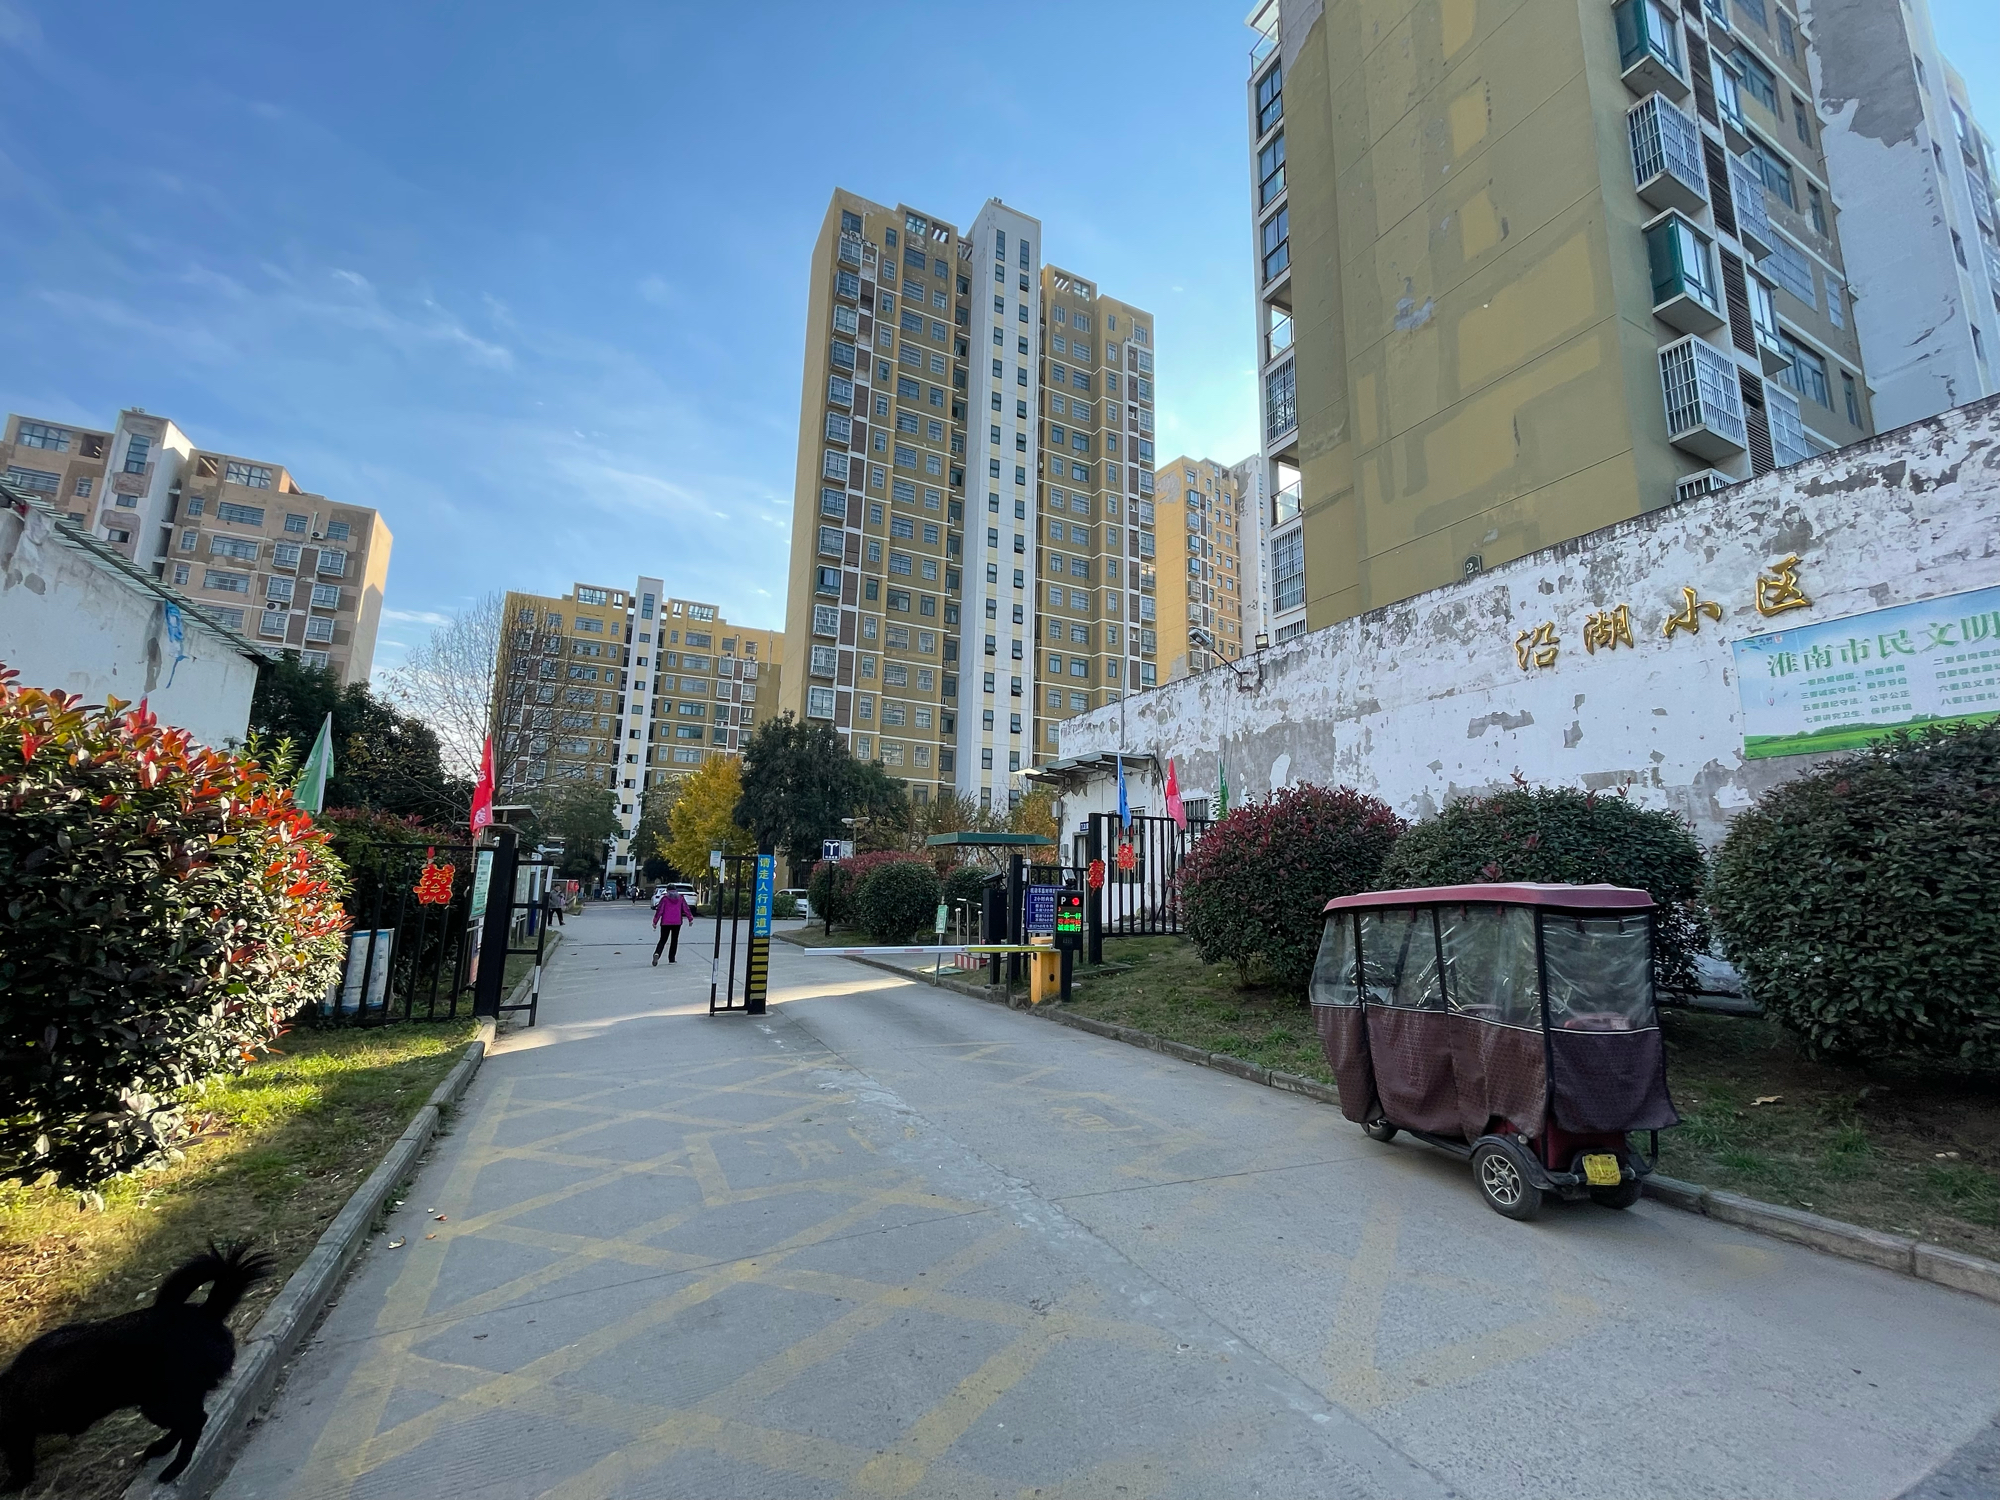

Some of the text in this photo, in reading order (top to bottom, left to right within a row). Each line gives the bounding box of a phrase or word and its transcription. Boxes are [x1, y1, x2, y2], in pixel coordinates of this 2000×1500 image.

[1514, 556, 1812, 671] 沿湖小区
[1767, 610, 2000, 677] 淮南市民文明
[755, 857, 771, 928] 请走人行通道
